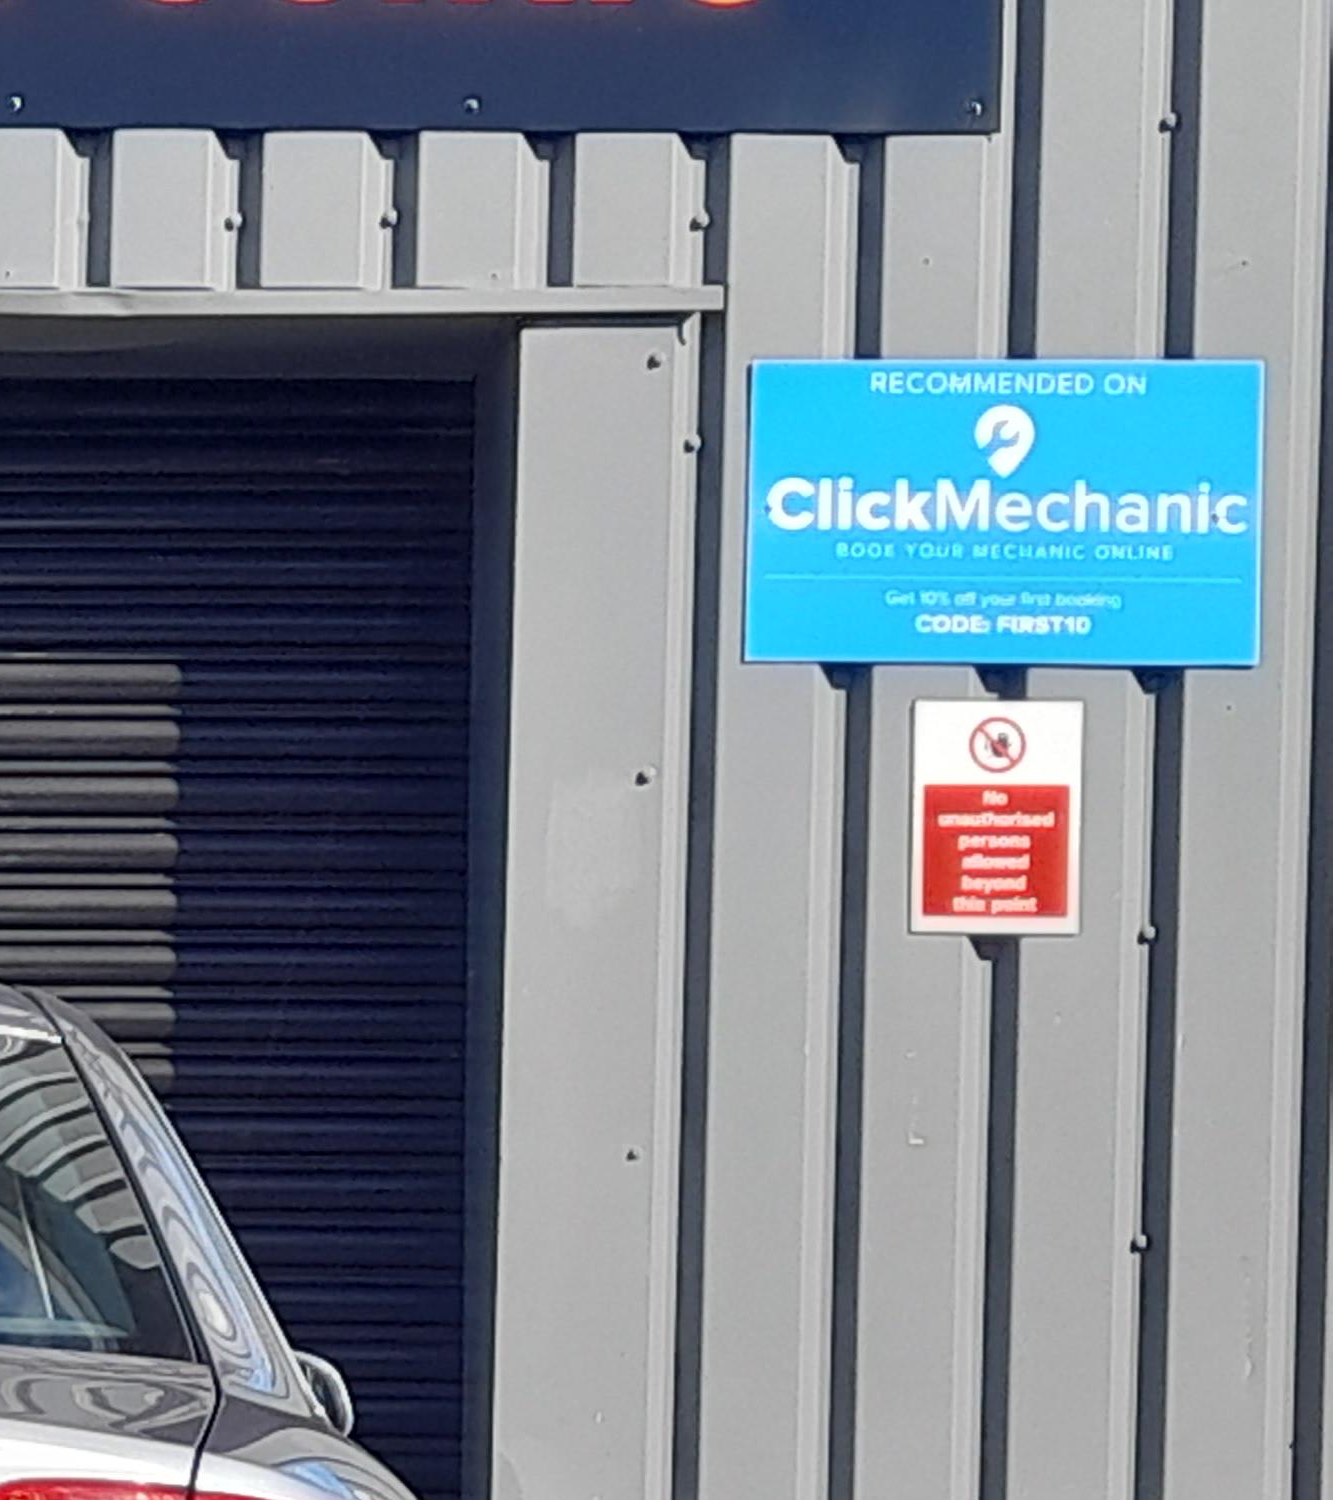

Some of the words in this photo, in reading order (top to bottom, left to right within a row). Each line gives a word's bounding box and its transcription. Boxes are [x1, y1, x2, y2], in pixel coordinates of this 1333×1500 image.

[869, 371, 1095, 395] RECOMMENDED
[1104, 373, 1147, 395] ON
[766, 477, 1249, 534] ClickMechanic
[836, 543, 895, 559] BOOK
[905, 543, 963, 559] YOUR
[973, 544, 1085, 560] MECHANIC
[1095, 545, 1175, 561] ONLINE
[885, 590, 915, 606] Get
[920, 590, 951, 606] 10%
[954, 591, 977, 607] off
[981, 594, 1016, 609] your
[1020, 591, 1051, 607] first
[1055, 591, 1122, 610] booking
[915, 614, 990, 633] CODE:
[997, 616, 1092, 635] FIRST10
[983, 790, 1009, 806] No
[958, 834, 1031, 851] persons
[961, 853, 1030, 870] allowed
[961, 875, 1027, 894] beyond
[952, 896, 986, 912] this
[991, 896, 1037, 915] point
